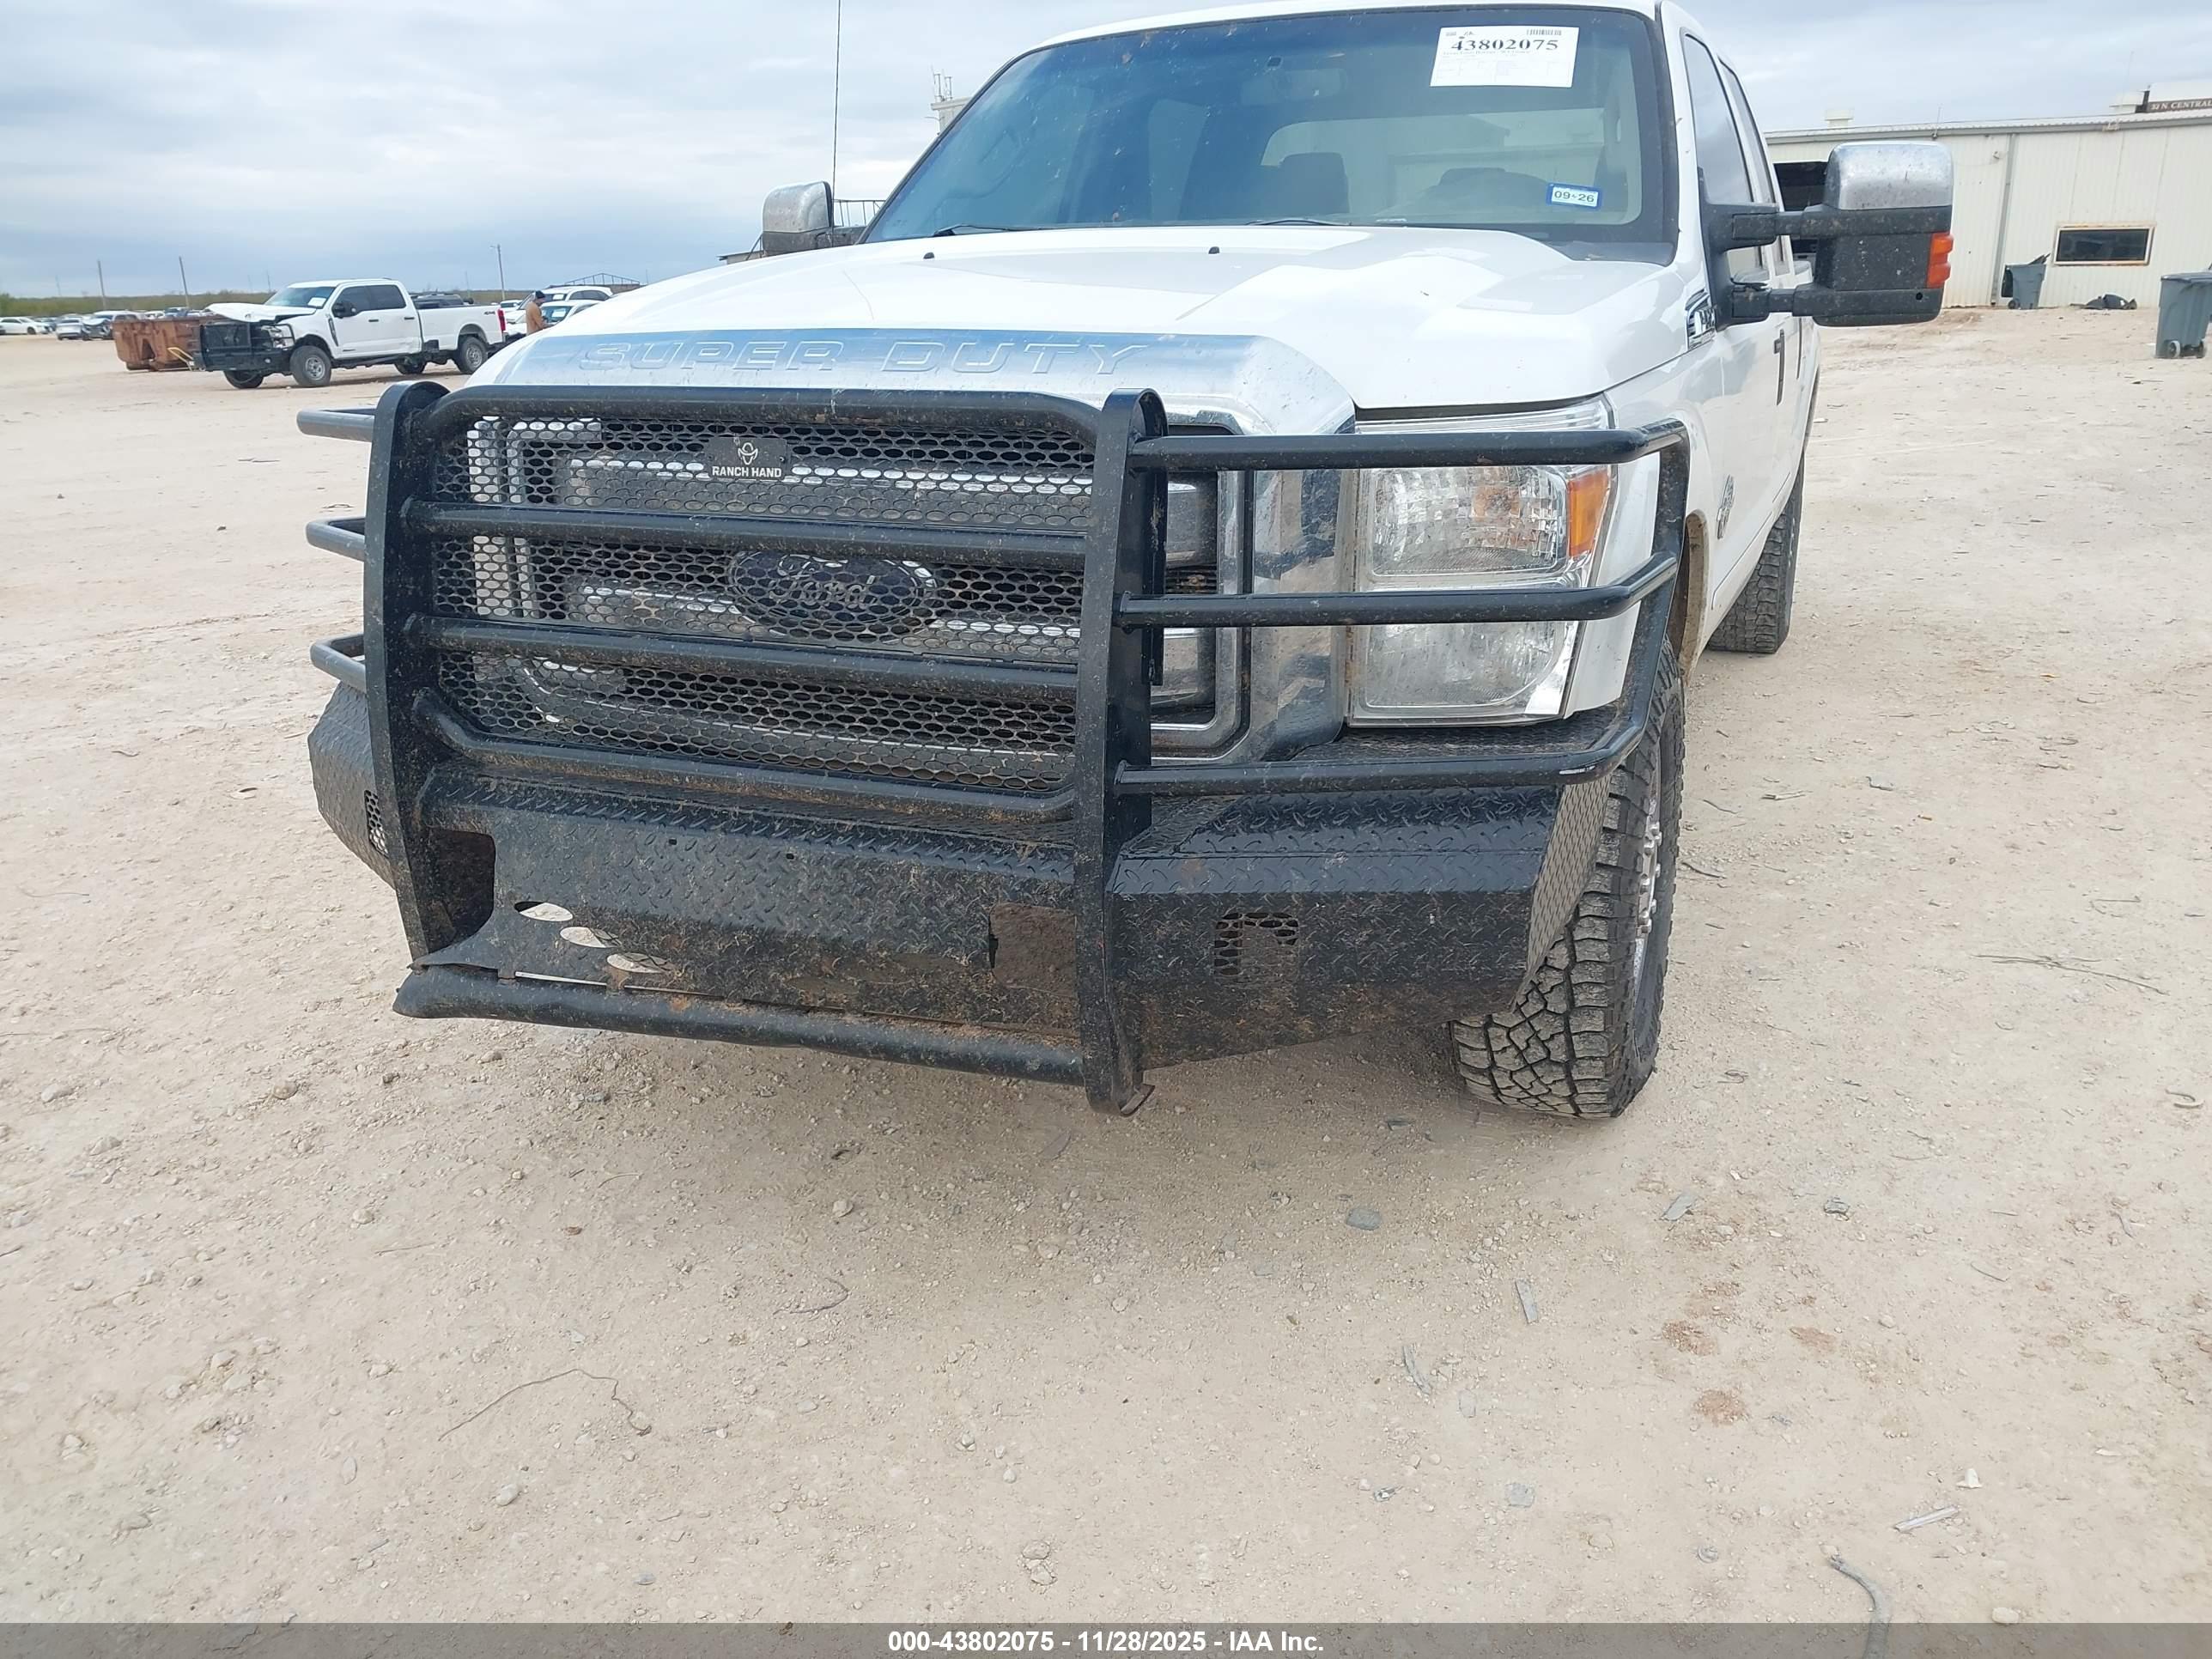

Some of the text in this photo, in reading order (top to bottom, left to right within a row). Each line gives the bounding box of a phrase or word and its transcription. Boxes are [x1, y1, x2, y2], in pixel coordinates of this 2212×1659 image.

[1450, 39, 1559, 52] 43802075
[579, 340, 1148, 375] SUPER DUTY
[711, 465, 782, 478] RANCH HAND
